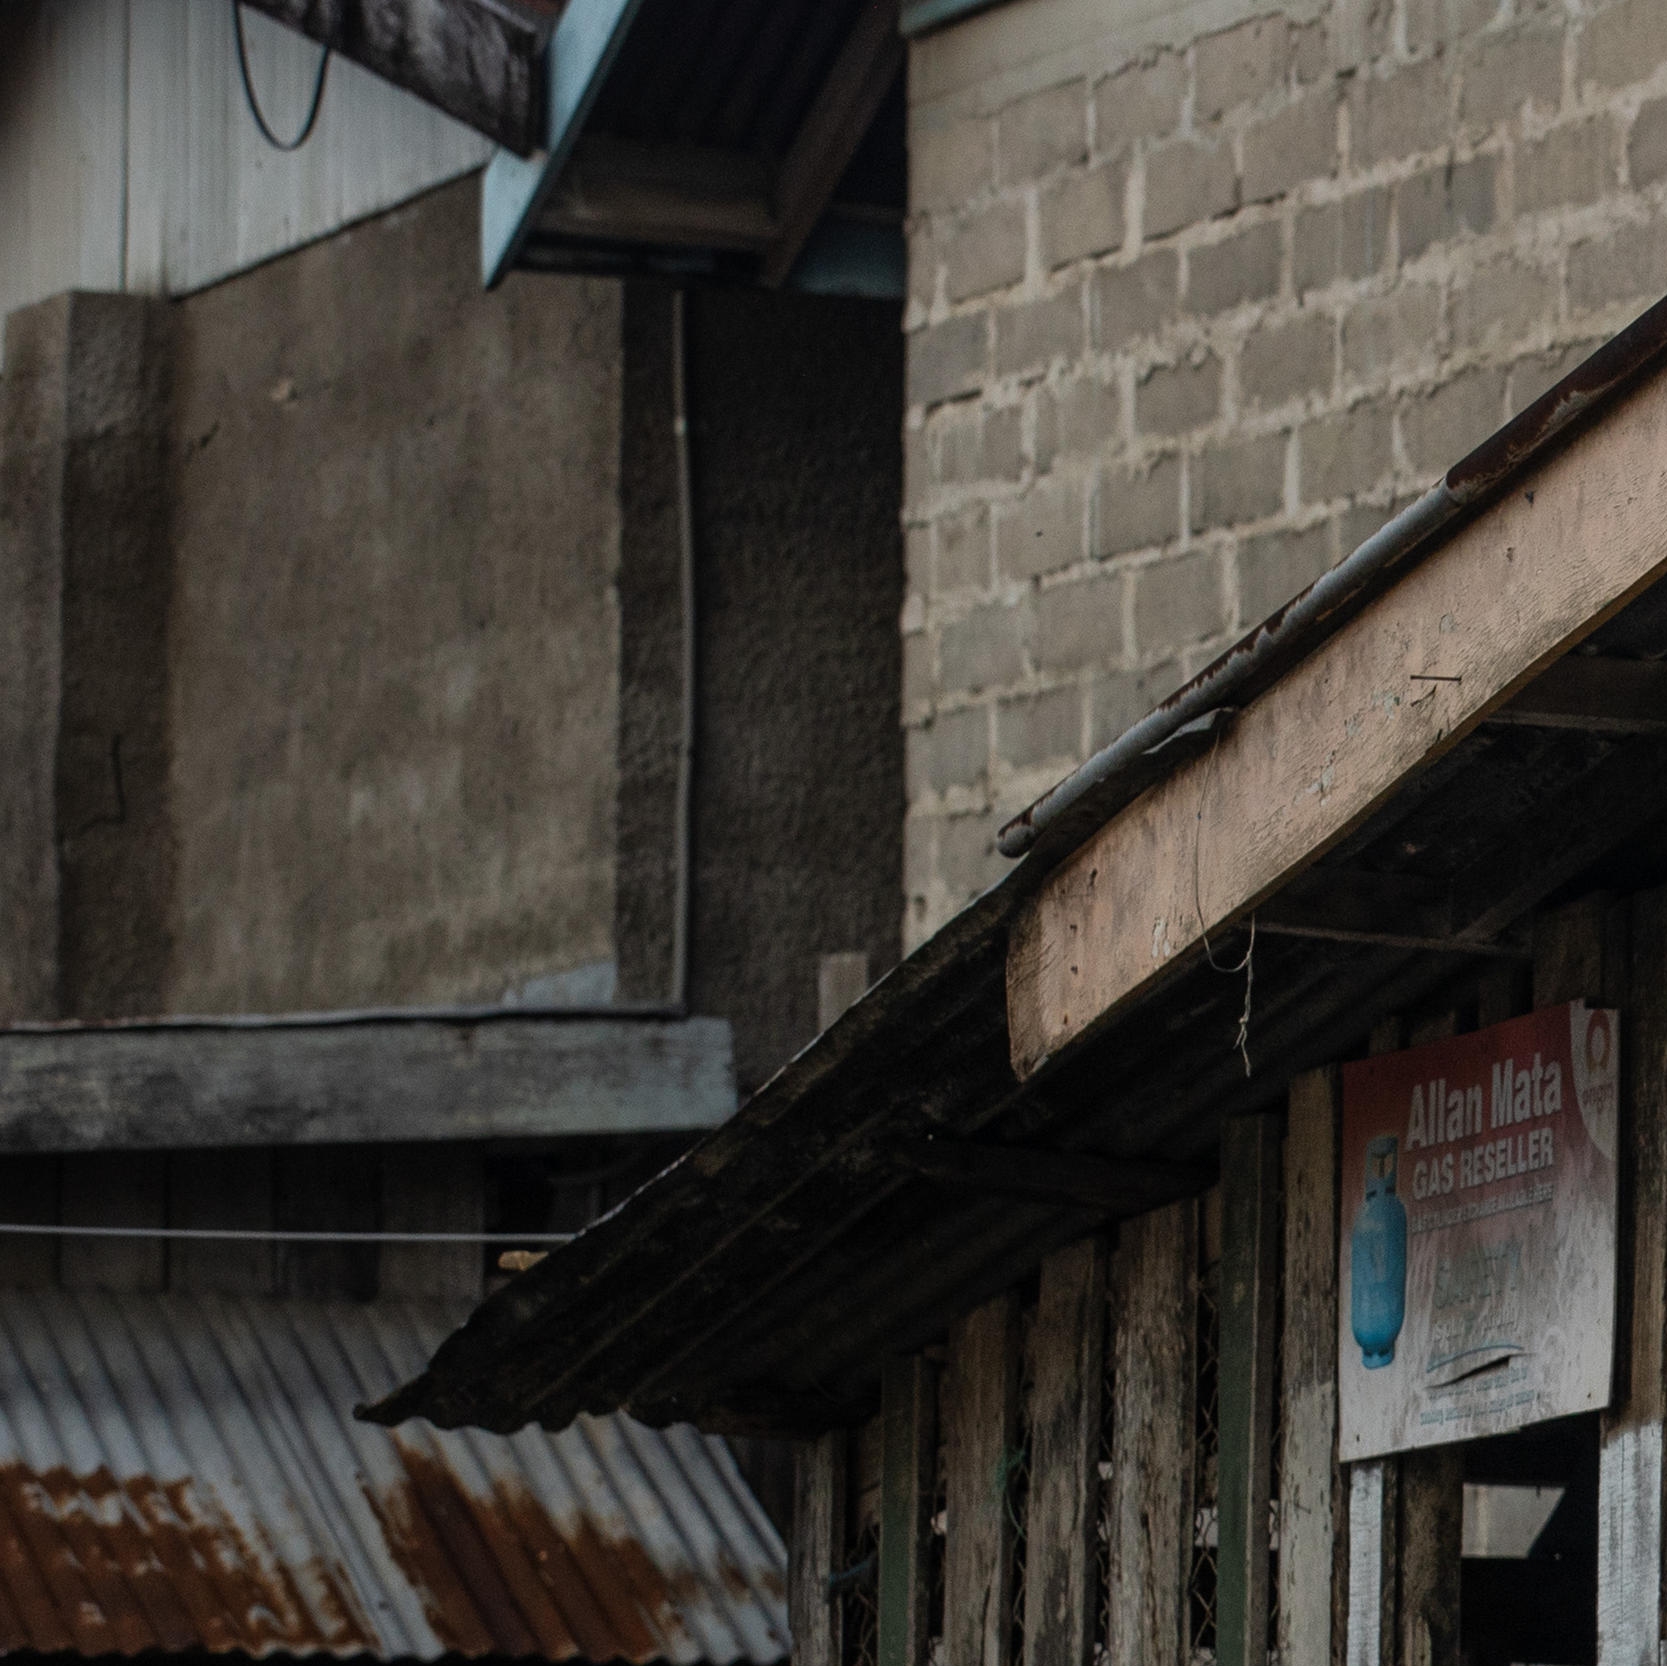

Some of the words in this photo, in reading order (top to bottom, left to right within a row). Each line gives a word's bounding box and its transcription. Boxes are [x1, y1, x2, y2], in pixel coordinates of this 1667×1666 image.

[1403, 1077, 1484, 1153] Allan
[1490, 1052, 1563, 1132] Mata
[1411, 1151, 1455, 1200] GAS
[1459, 1126, 1556, 1191] RESELLER
